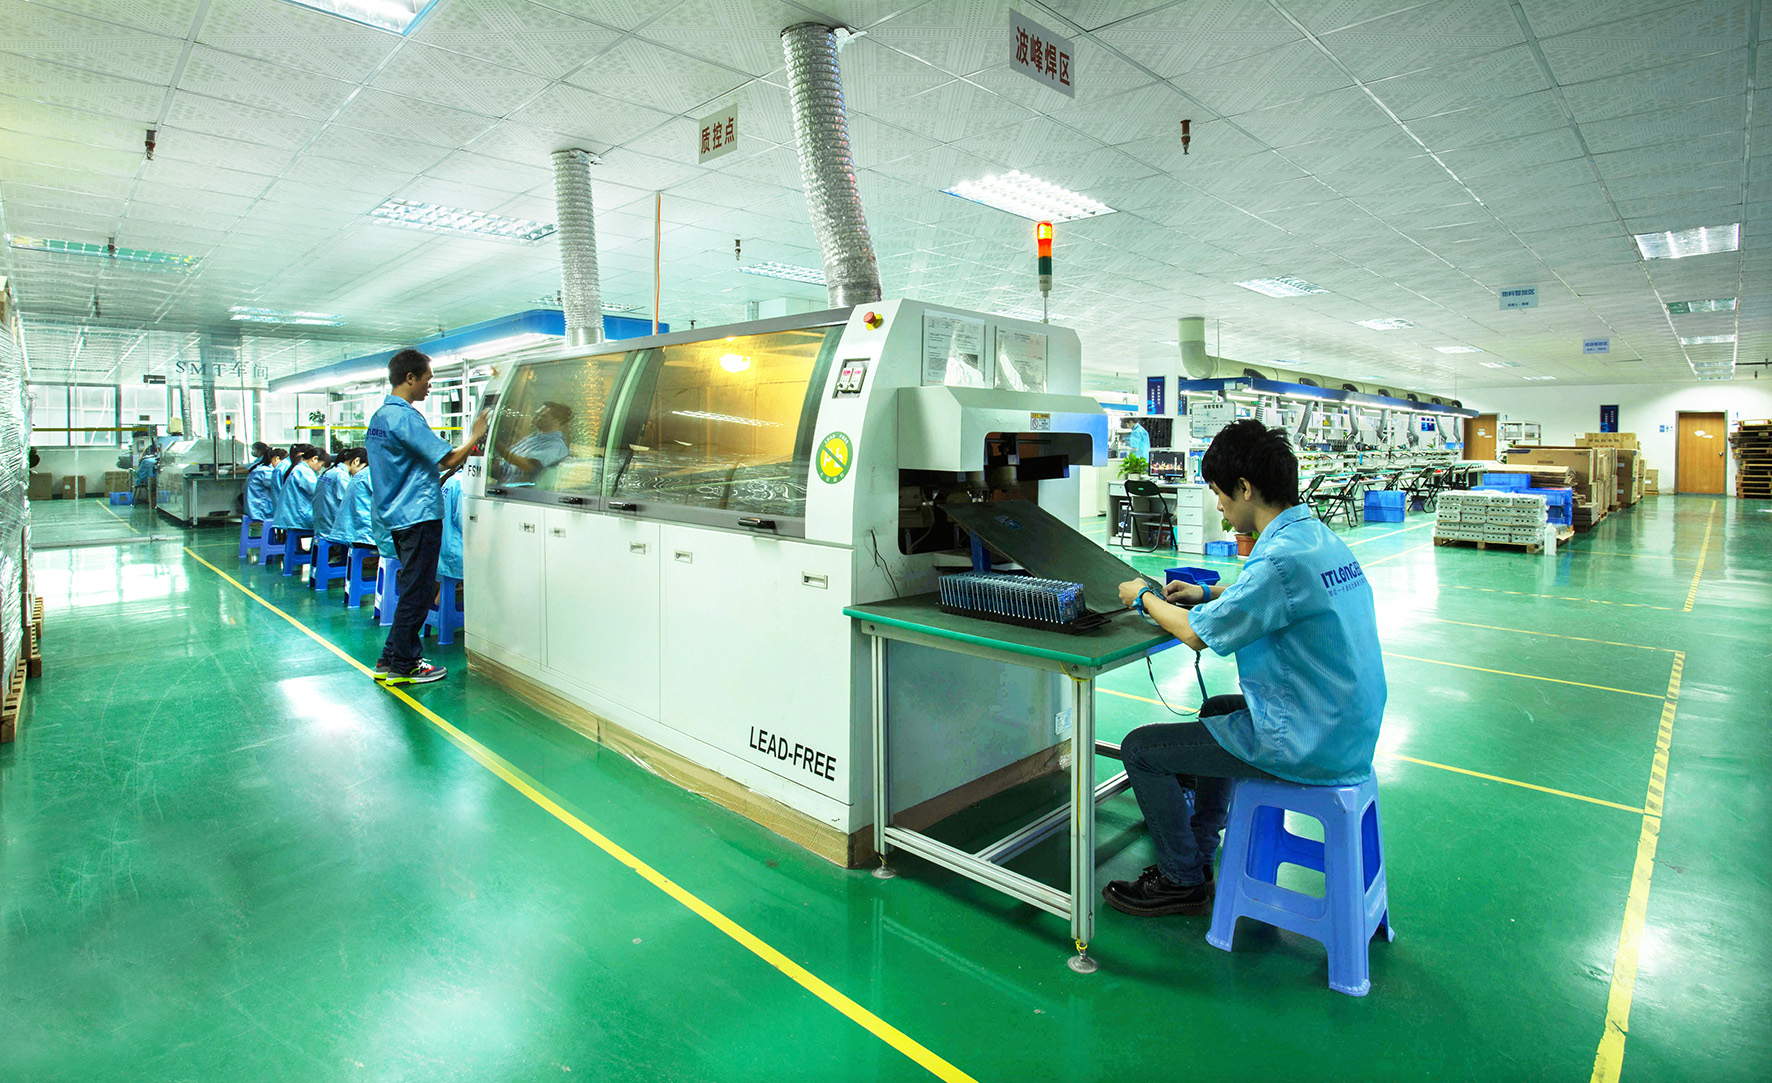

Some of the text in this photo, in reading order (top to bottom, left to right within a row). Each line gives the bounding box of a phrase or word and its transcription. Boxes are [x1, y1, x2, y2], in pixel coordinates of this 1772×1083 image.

[1015, 25, 1071, 87] 波峰焊区
[700, 116, 735, 154] 质控点
[467, 464, 482, 478] FSM
[749, 725, 837, 782] LEAD-FREE
